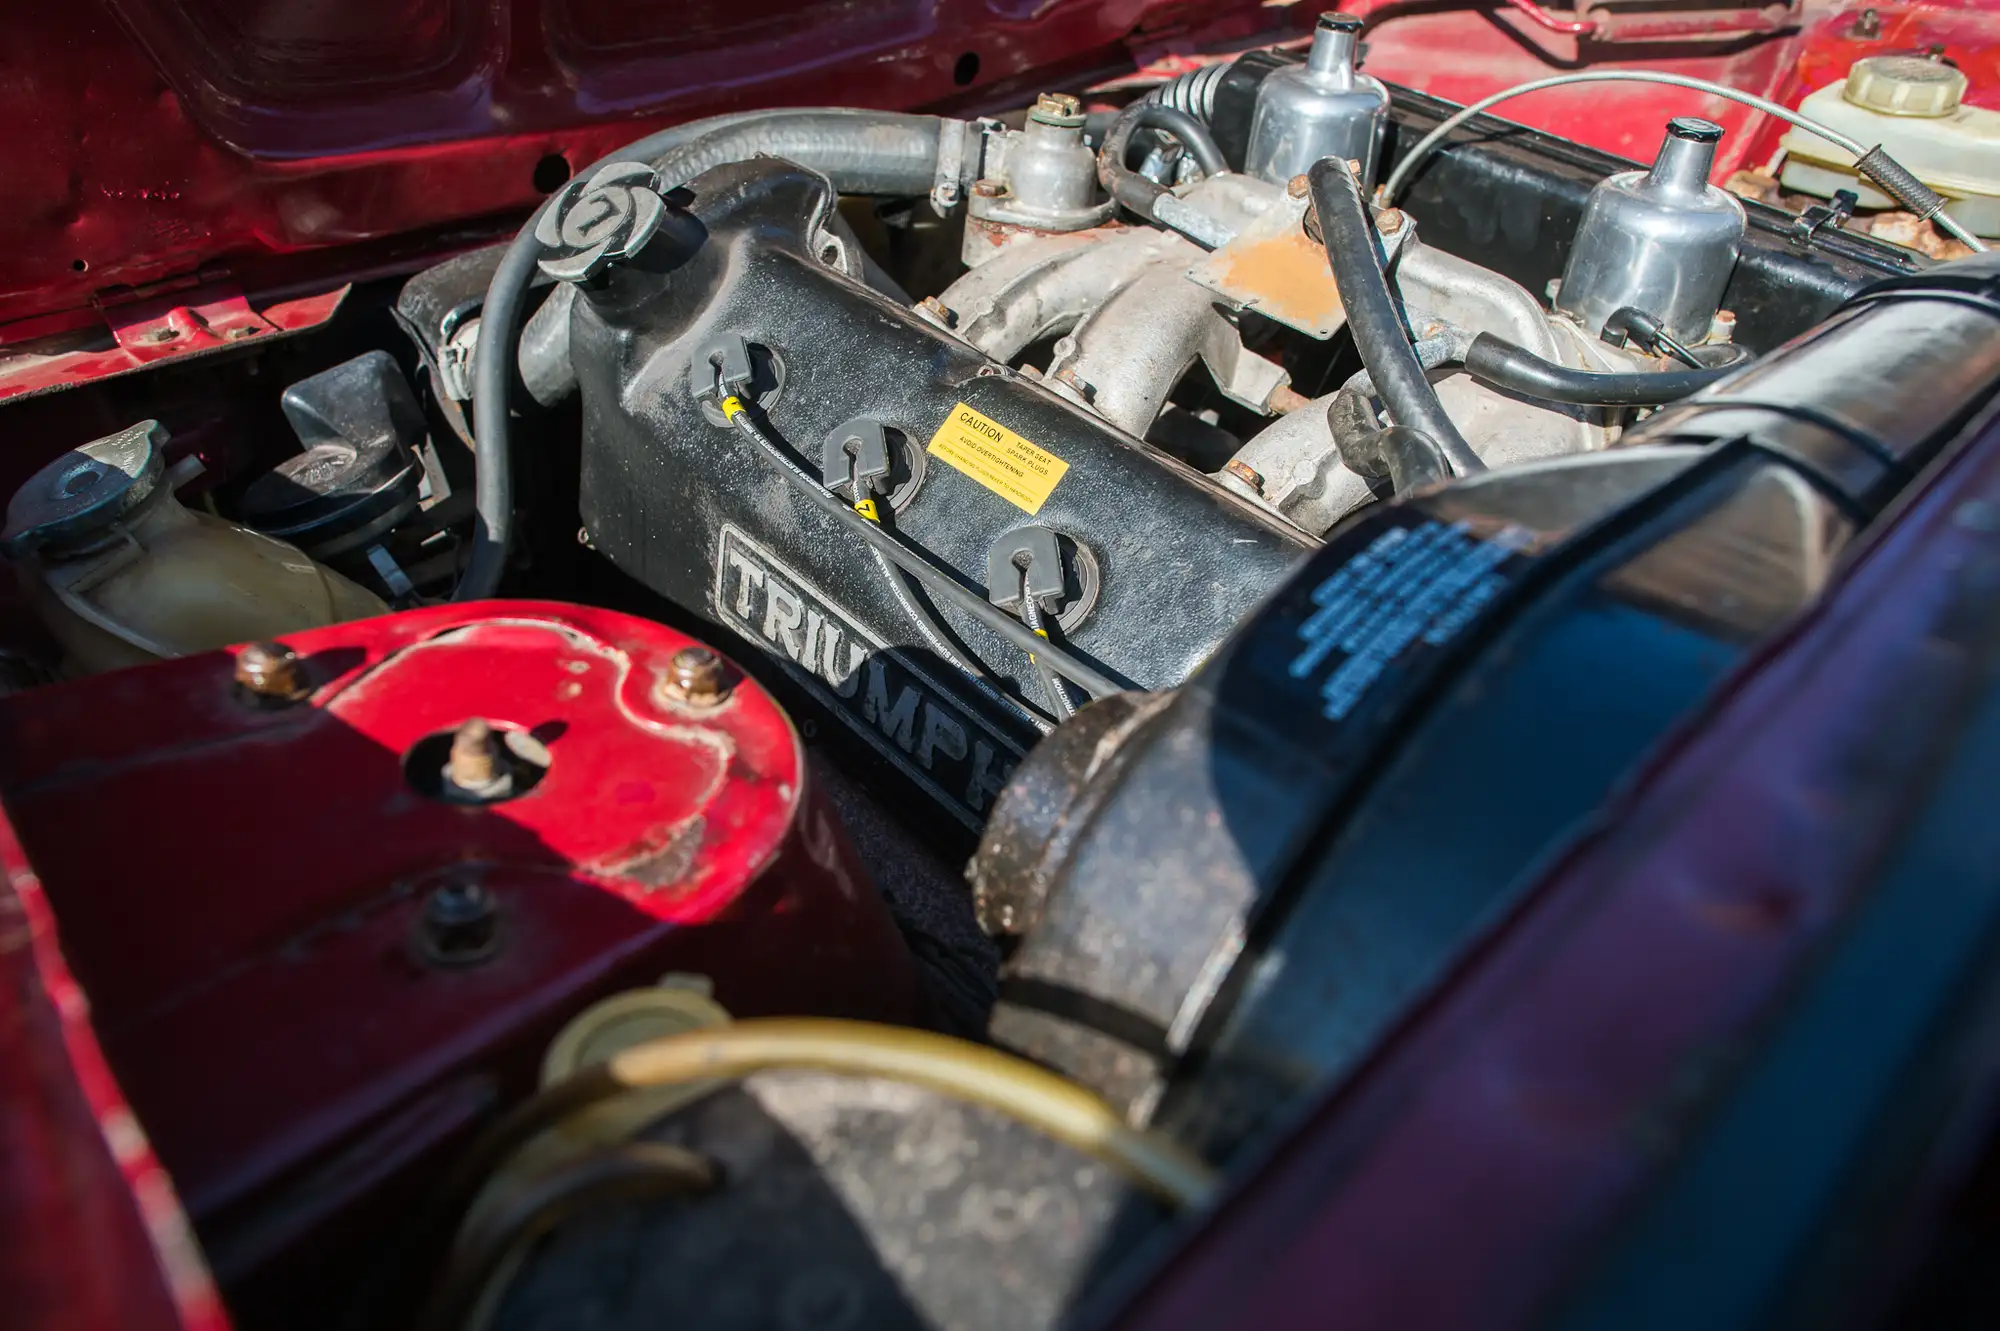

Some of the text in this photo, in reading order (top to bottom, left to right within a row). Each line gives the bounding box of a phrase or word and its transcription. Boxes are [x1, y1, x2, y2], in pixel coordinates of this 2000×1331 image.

[960, 412, 1004, 443] CAUTION
[960, 436, 1025, 478] AVOID OVERTIGHTENING
[1006, 448, 1049, 476] SPARK PLUGS
[1015, 441, 1052, 466] TAPER SEAT
[881, 564, 890, 578] ALL
[888, 580, 918, 622] CONDUCTOR
[916, 619, 951, 659] SUPPRESSED
[949, 654, 962, 669] EMI
[961, 667, 999, 701] INDUCTANCE
[998, 696, 1031, 724] METALLIC
